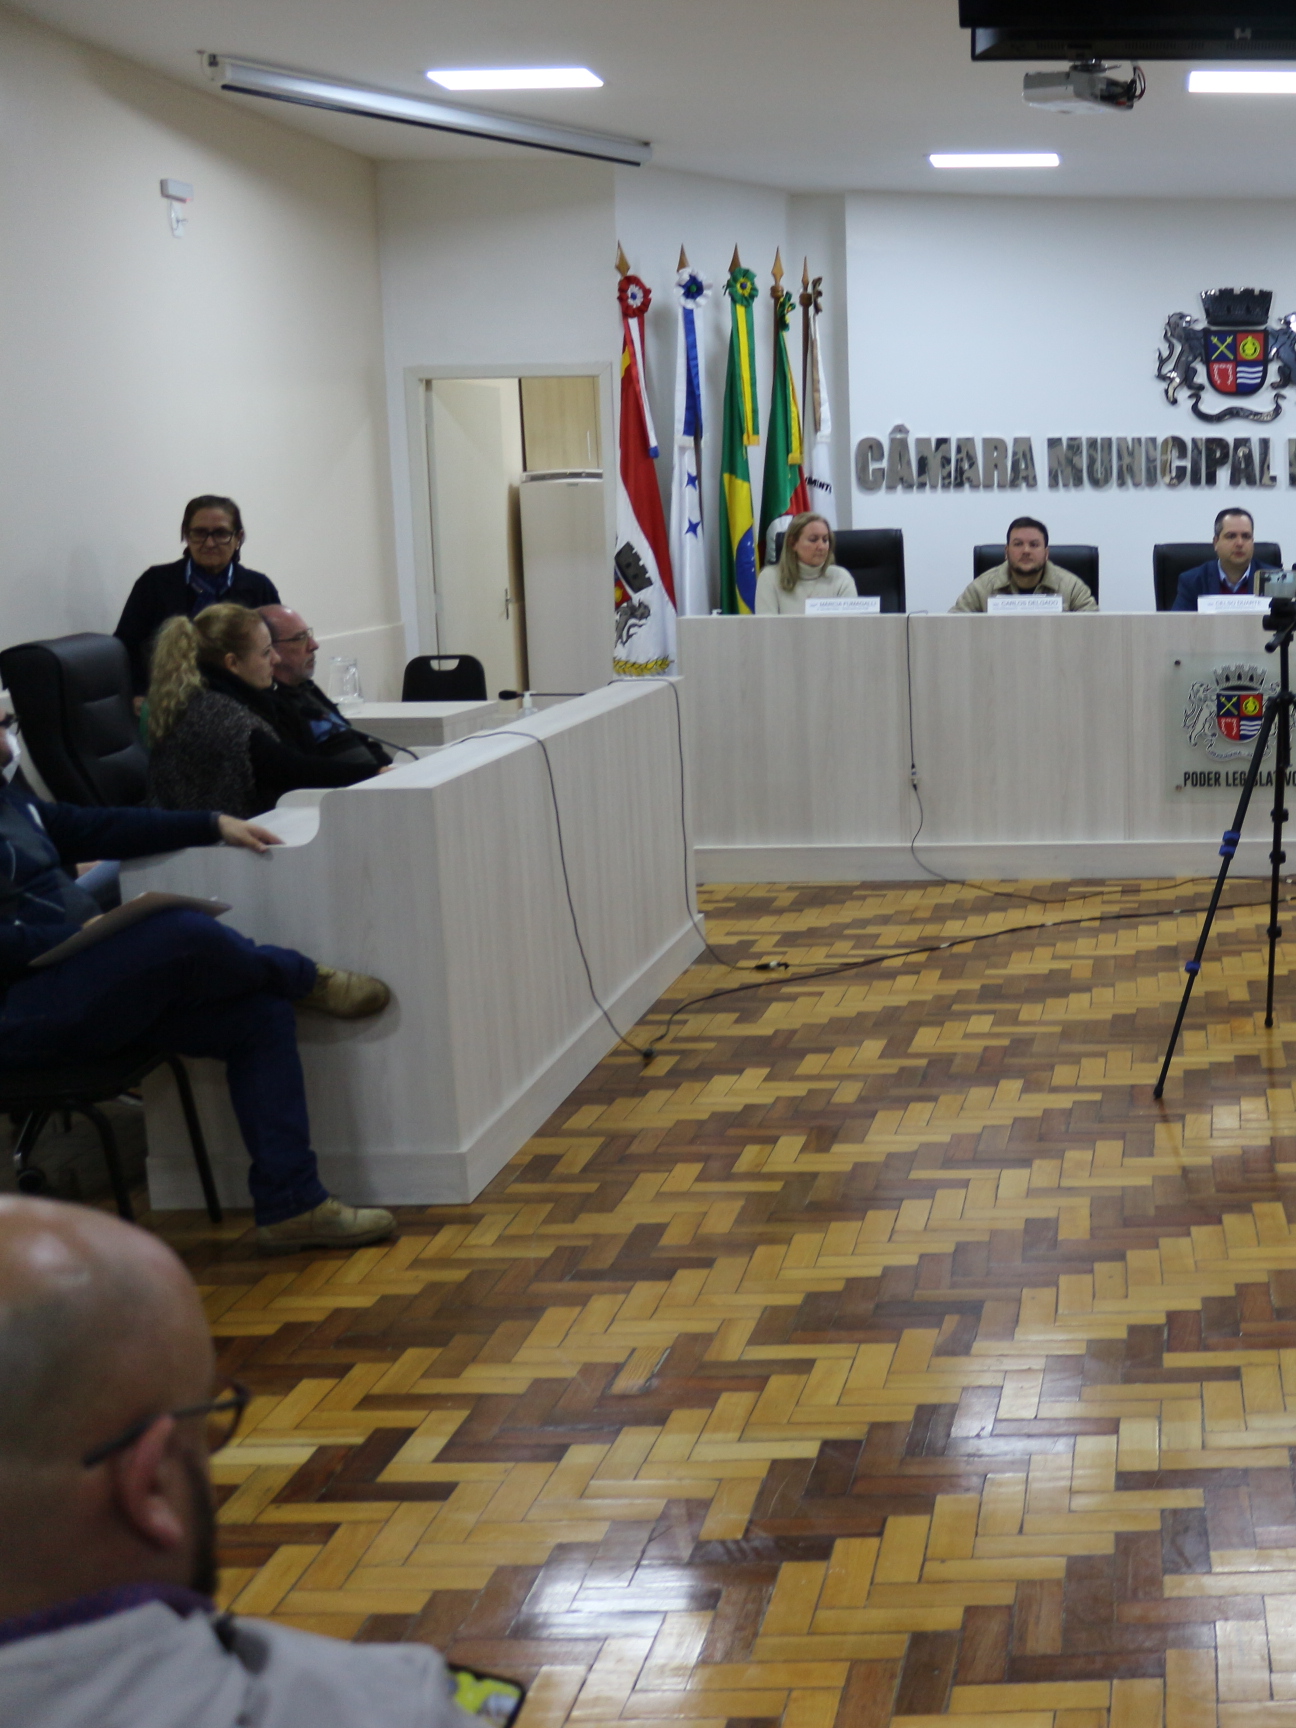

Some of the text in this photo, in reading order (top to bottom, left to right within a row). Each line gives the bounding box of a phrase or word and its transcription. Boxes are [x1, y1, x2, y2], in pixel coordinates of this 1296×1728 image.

[855, 424, 1037, 490] CÂMARA
[1047, 435, 1278, 488] MUNICIPAL
[1183, 771, 1221, 788] PODER
